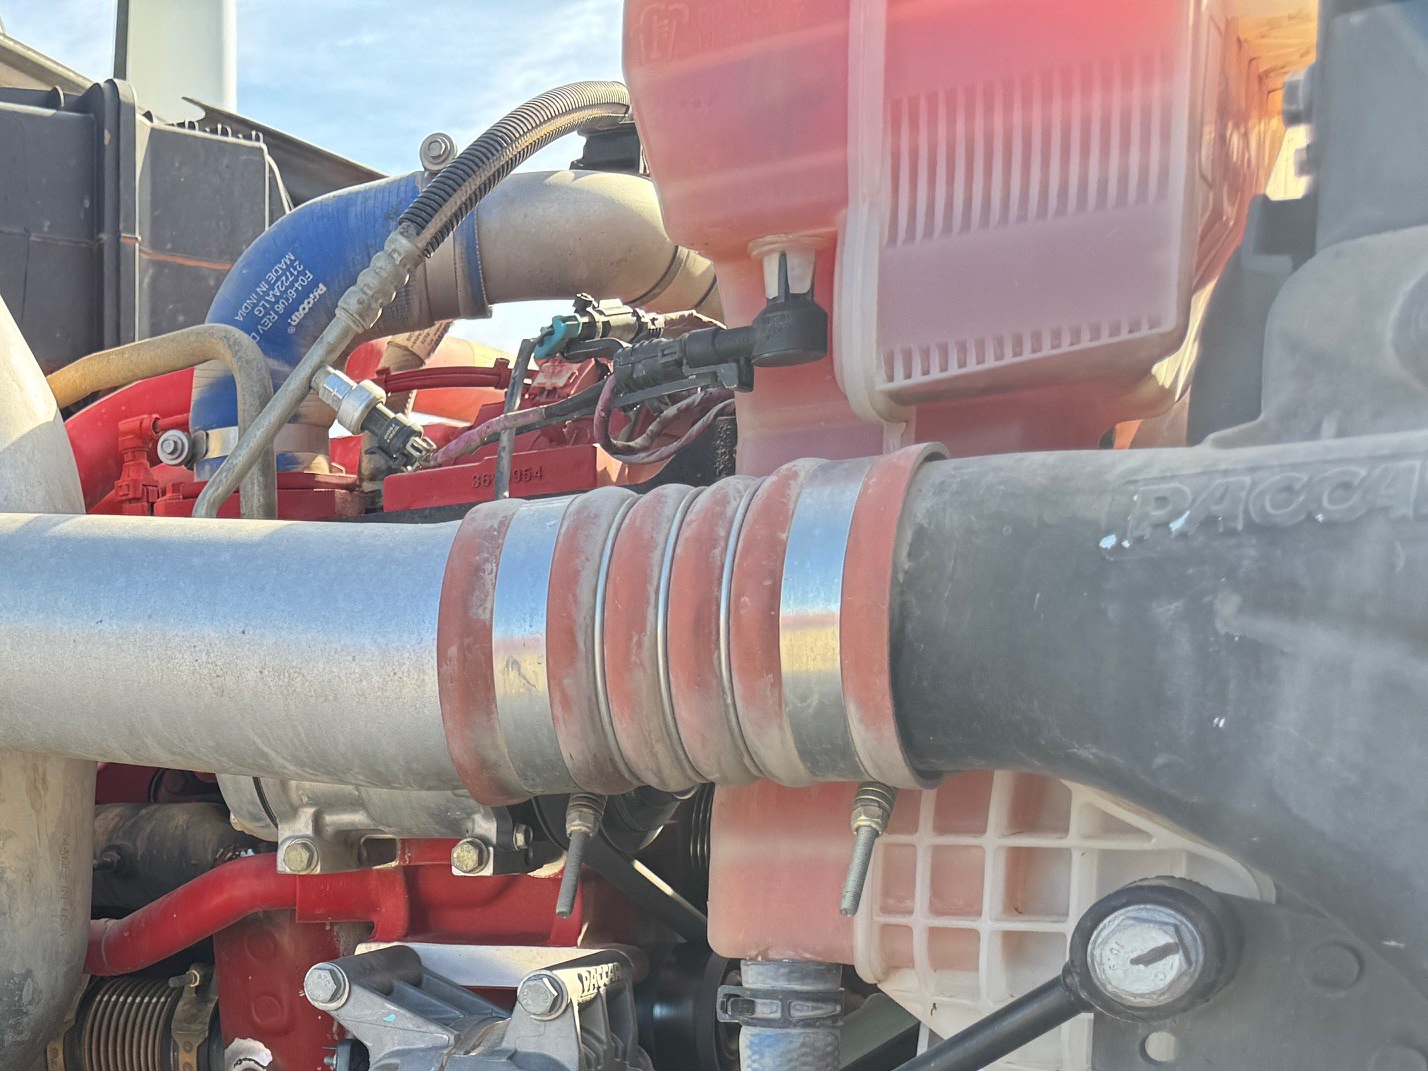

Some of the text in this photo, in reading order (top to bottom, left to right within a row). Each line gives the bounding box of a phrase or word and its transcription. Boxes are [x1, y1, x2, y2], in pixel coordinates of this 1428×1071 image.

[233, 250, 294, 322] MADE IN INDIA
[252, 258, 303, 317] 21722AA LG
[255, 310, 278, 334] REV
[473, 466, 542, 488] 36954
[1128, 459, 1428, 541] PACCA
